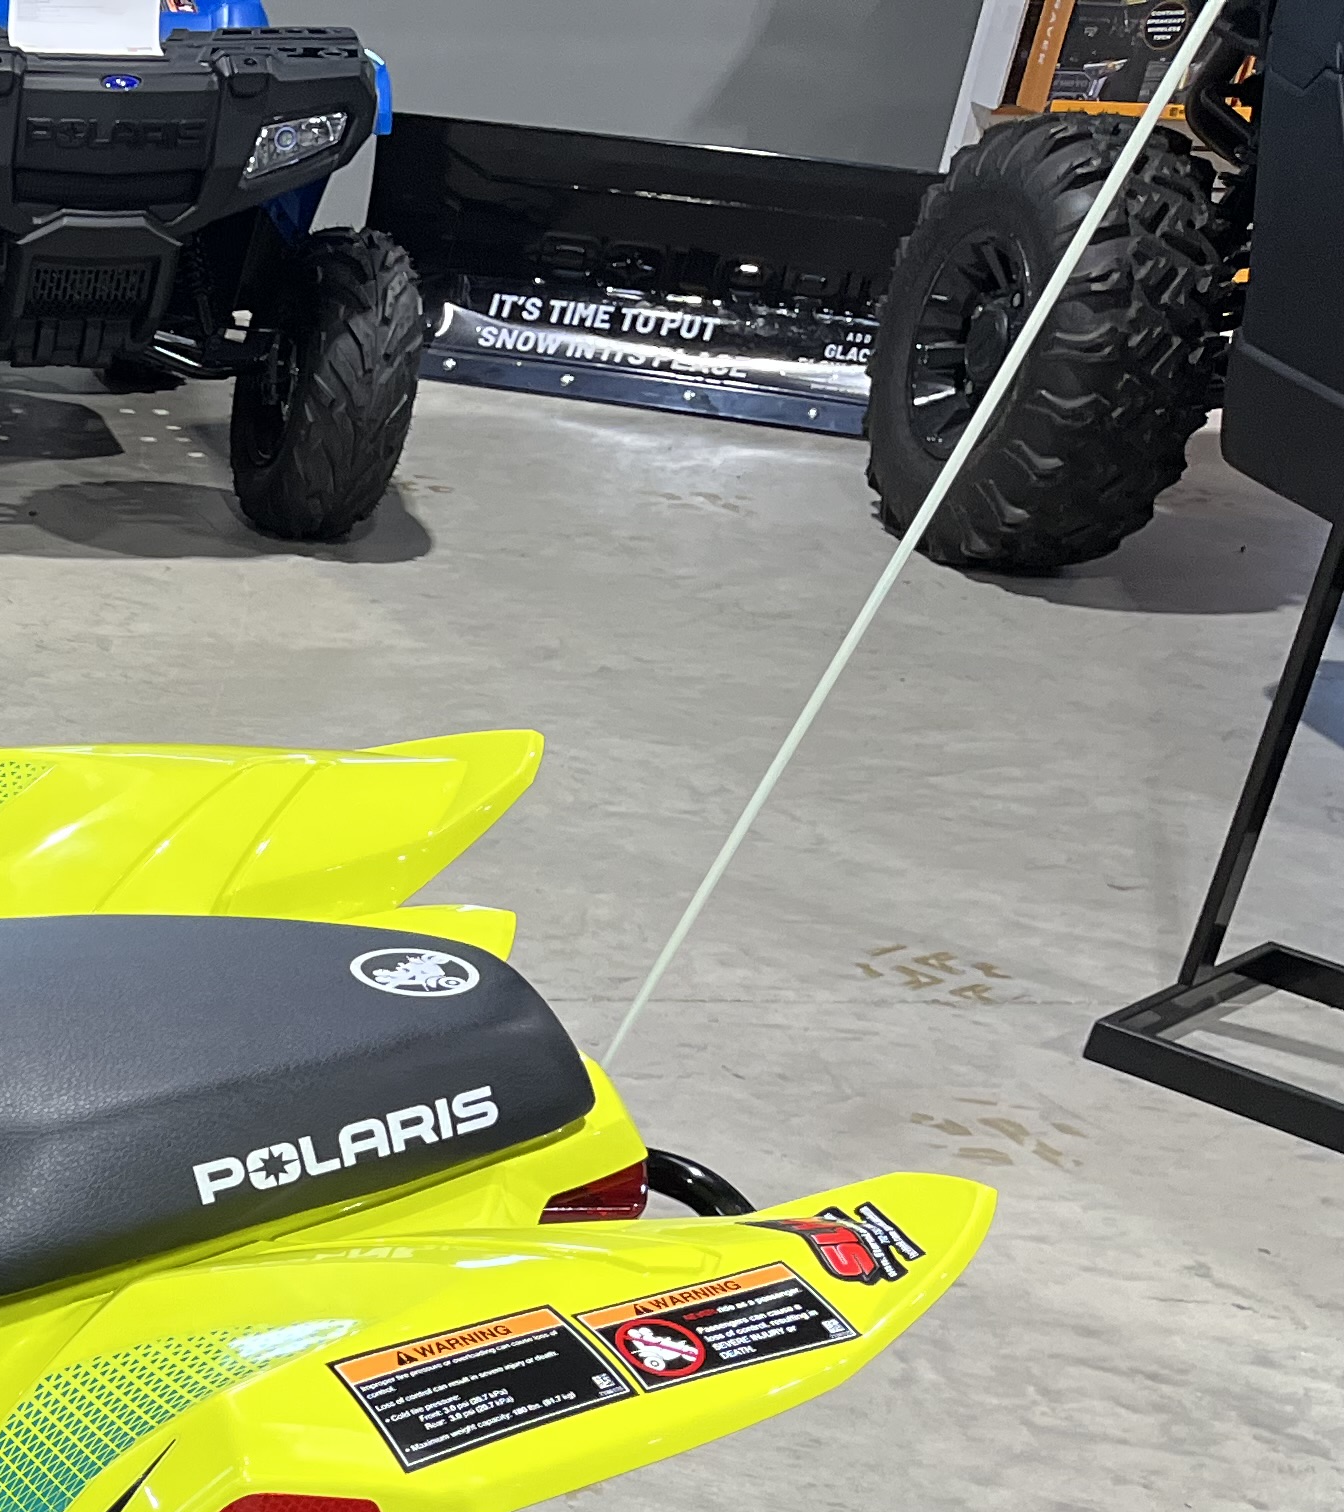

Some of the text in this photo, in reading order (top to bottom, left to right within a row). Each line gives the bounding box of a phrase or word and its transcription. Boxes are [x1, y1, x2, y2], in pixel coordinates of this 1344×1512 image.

[26, 116, 209, 147] POLARIS
[488, 291, 720, 344] IT'S TIME TO PUT
[192, 1085, 500, 1206] POLARIS
[646, 1279, 743, 1311] WARNING
[693, 1315, 750, 1335] Passengers
[710, 1335, 753, 1352] SEVERE
[748, 1326, 788, 1342] INJURY
[411, 1322, 514, 1359] WARNING
[717, 1344, 758, 1360] DEATH.
[372, 1399, 397, 1411] Loss
[388, 1409, 411, 1422] Cold
